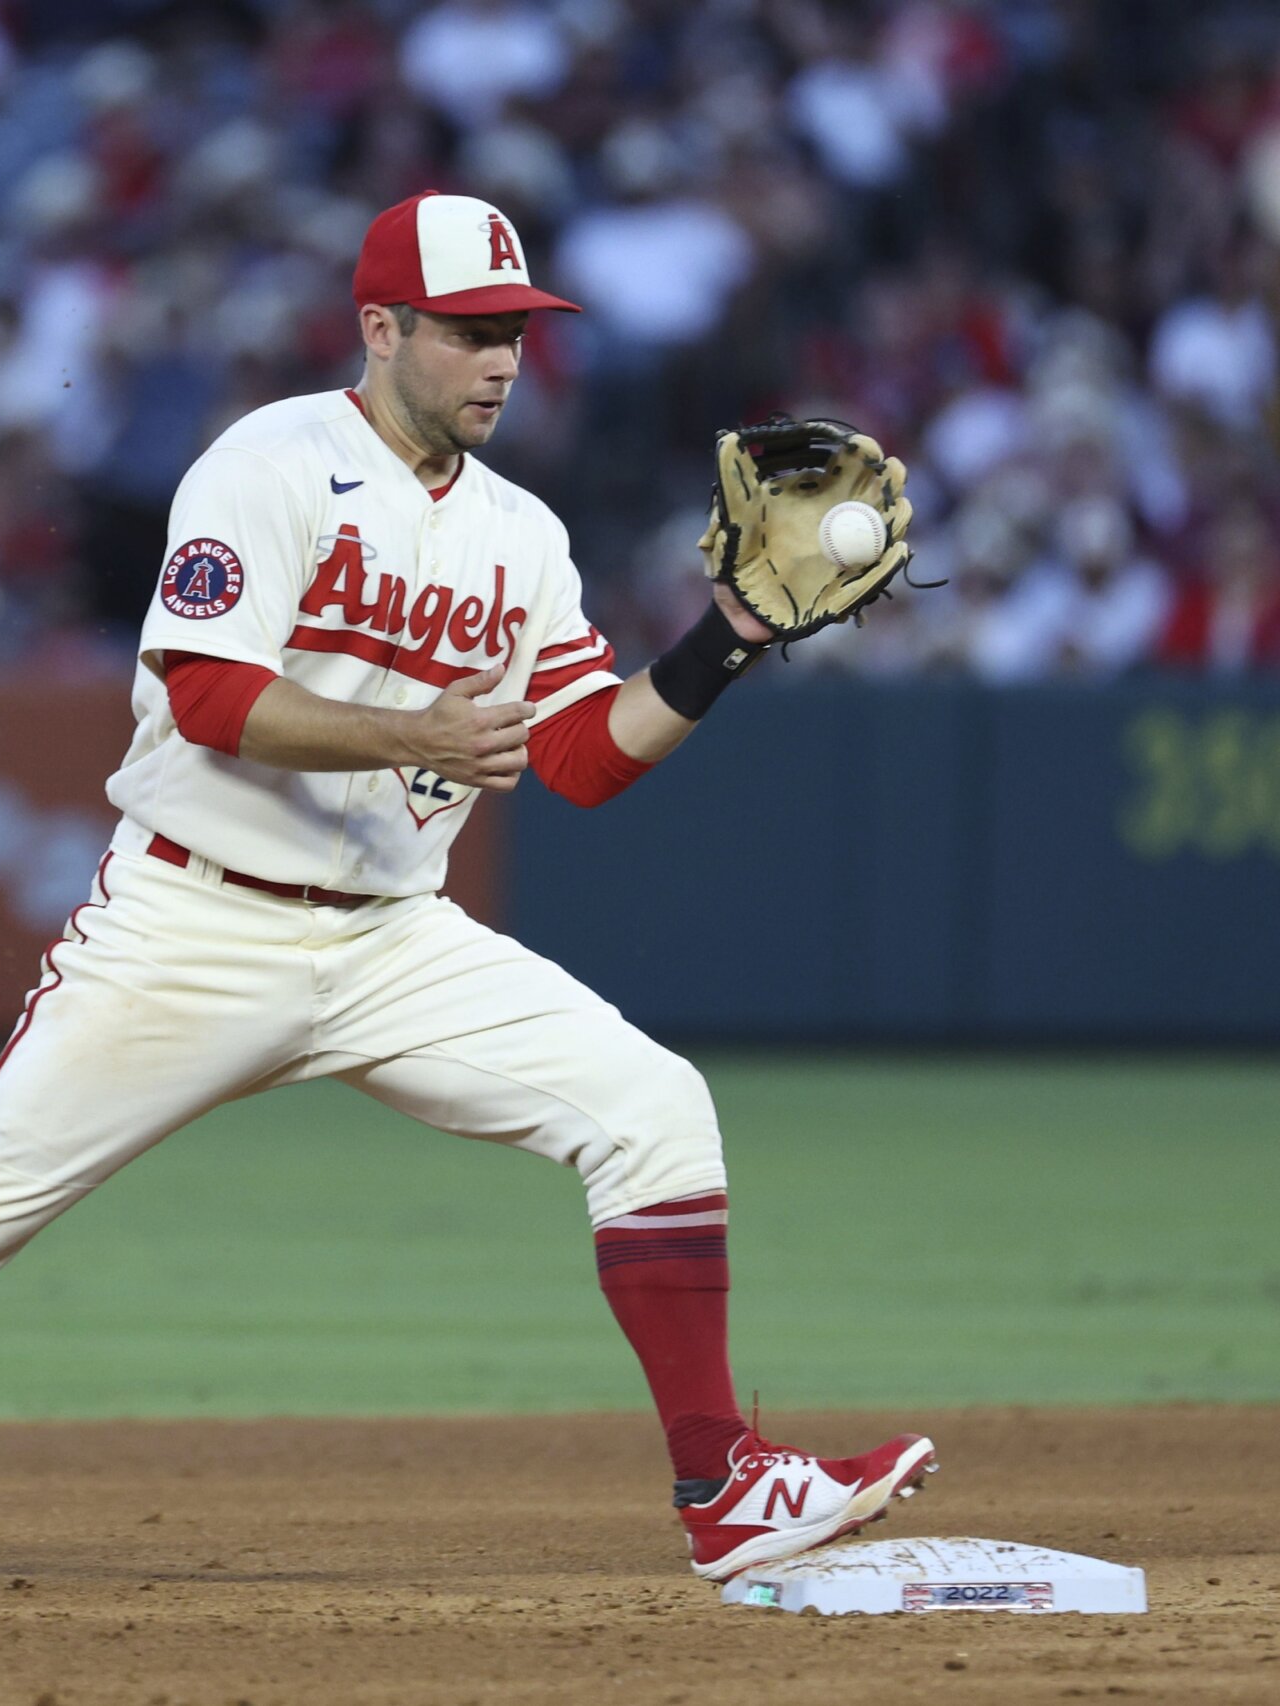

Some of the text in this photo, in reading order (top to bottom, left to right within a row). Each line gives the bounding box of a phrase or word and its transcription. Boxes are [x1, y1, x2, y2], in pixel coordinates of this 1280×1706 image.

[487, 213, 522, 271] A
[164, 542, 241, 594] LOS ANGELES
[182, 557, 211, 599] A
[164, 594, 227, 617] ANGELS
[298, 523, 527, 672] Angels
[763, 1476, 812, 1520] N
[946, 1586, 1009, 1600] 2022
